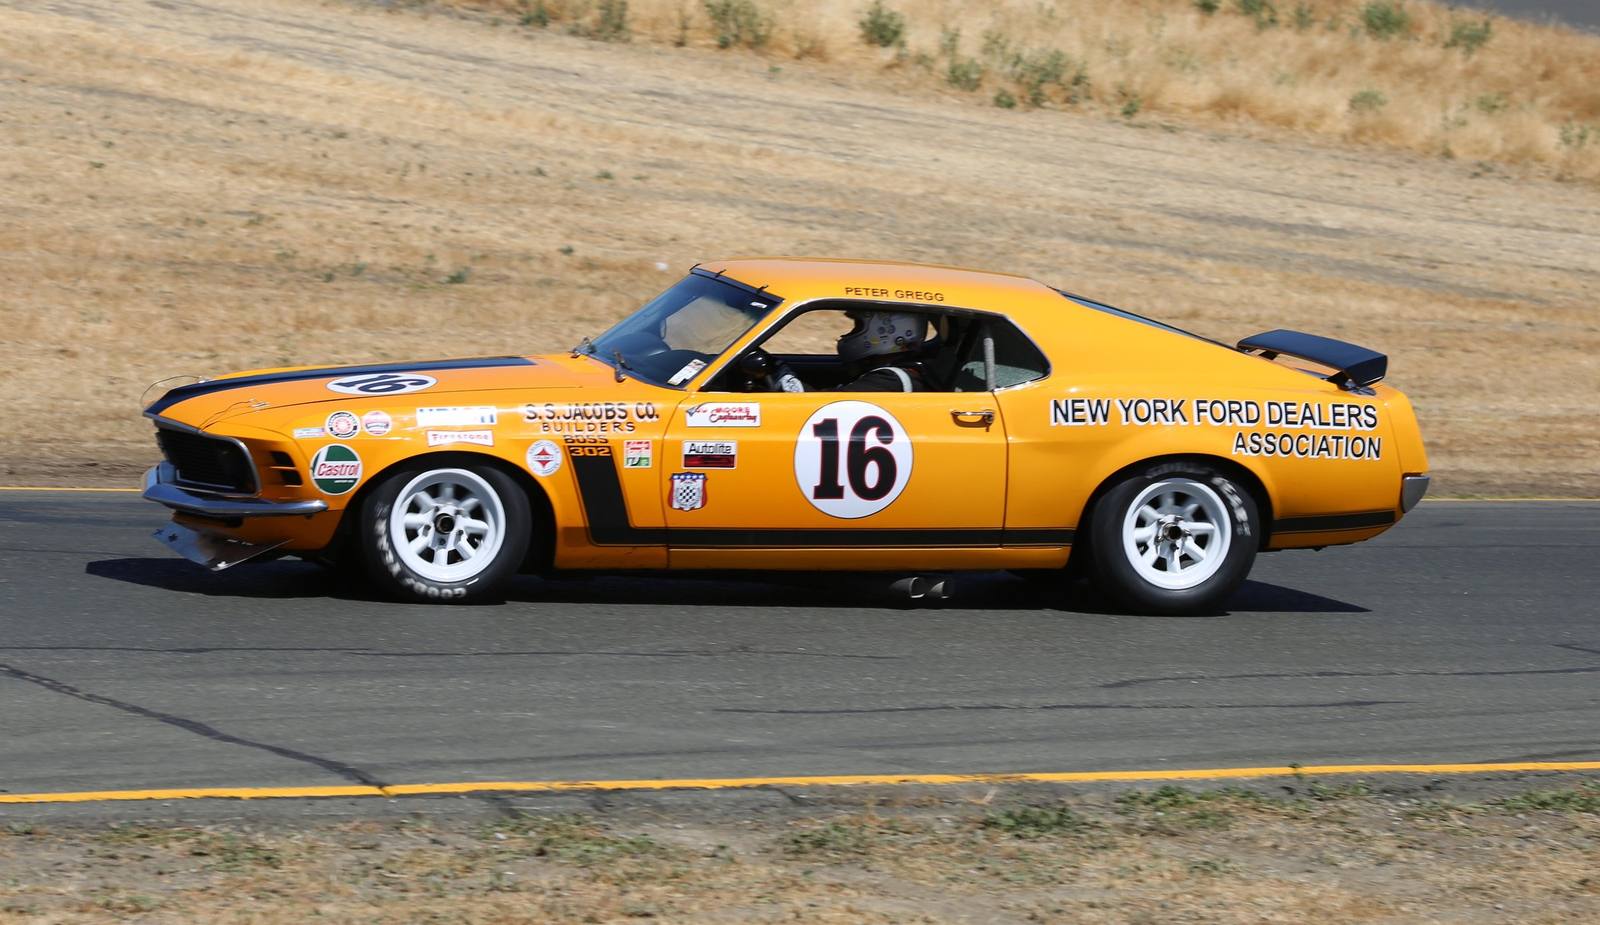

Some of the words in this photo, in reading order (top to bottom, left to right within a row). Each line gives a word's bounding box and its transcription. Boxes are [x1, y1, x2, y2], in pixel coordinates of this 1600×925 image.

[845, 286, 889, 298] PETER
[895, 289, 945, 302] GREGG
[334, 374, 430, 393] 16
[563, 403, 628, 420] JACOBS
[635, 402, 660, 420] CO.
[1051, 399, 1111, 425] NEW
[1117, 399, 1189, 425] YORK
[1194, 399, 1261, 427] FORD
[1266, 401, 1379, 430] DEALERS
[541, 421, 636, 432] BUILDERS
[563, 435, 609, 444] BOSS
[1233, 432, 1382, 460] ASSOCIATION
[569, 446, 611, 457] 302
[688, 443, 732, 454] Autolite
[812, 415, 897, 502] 16
[317, 462, 361, 477] Castrol
